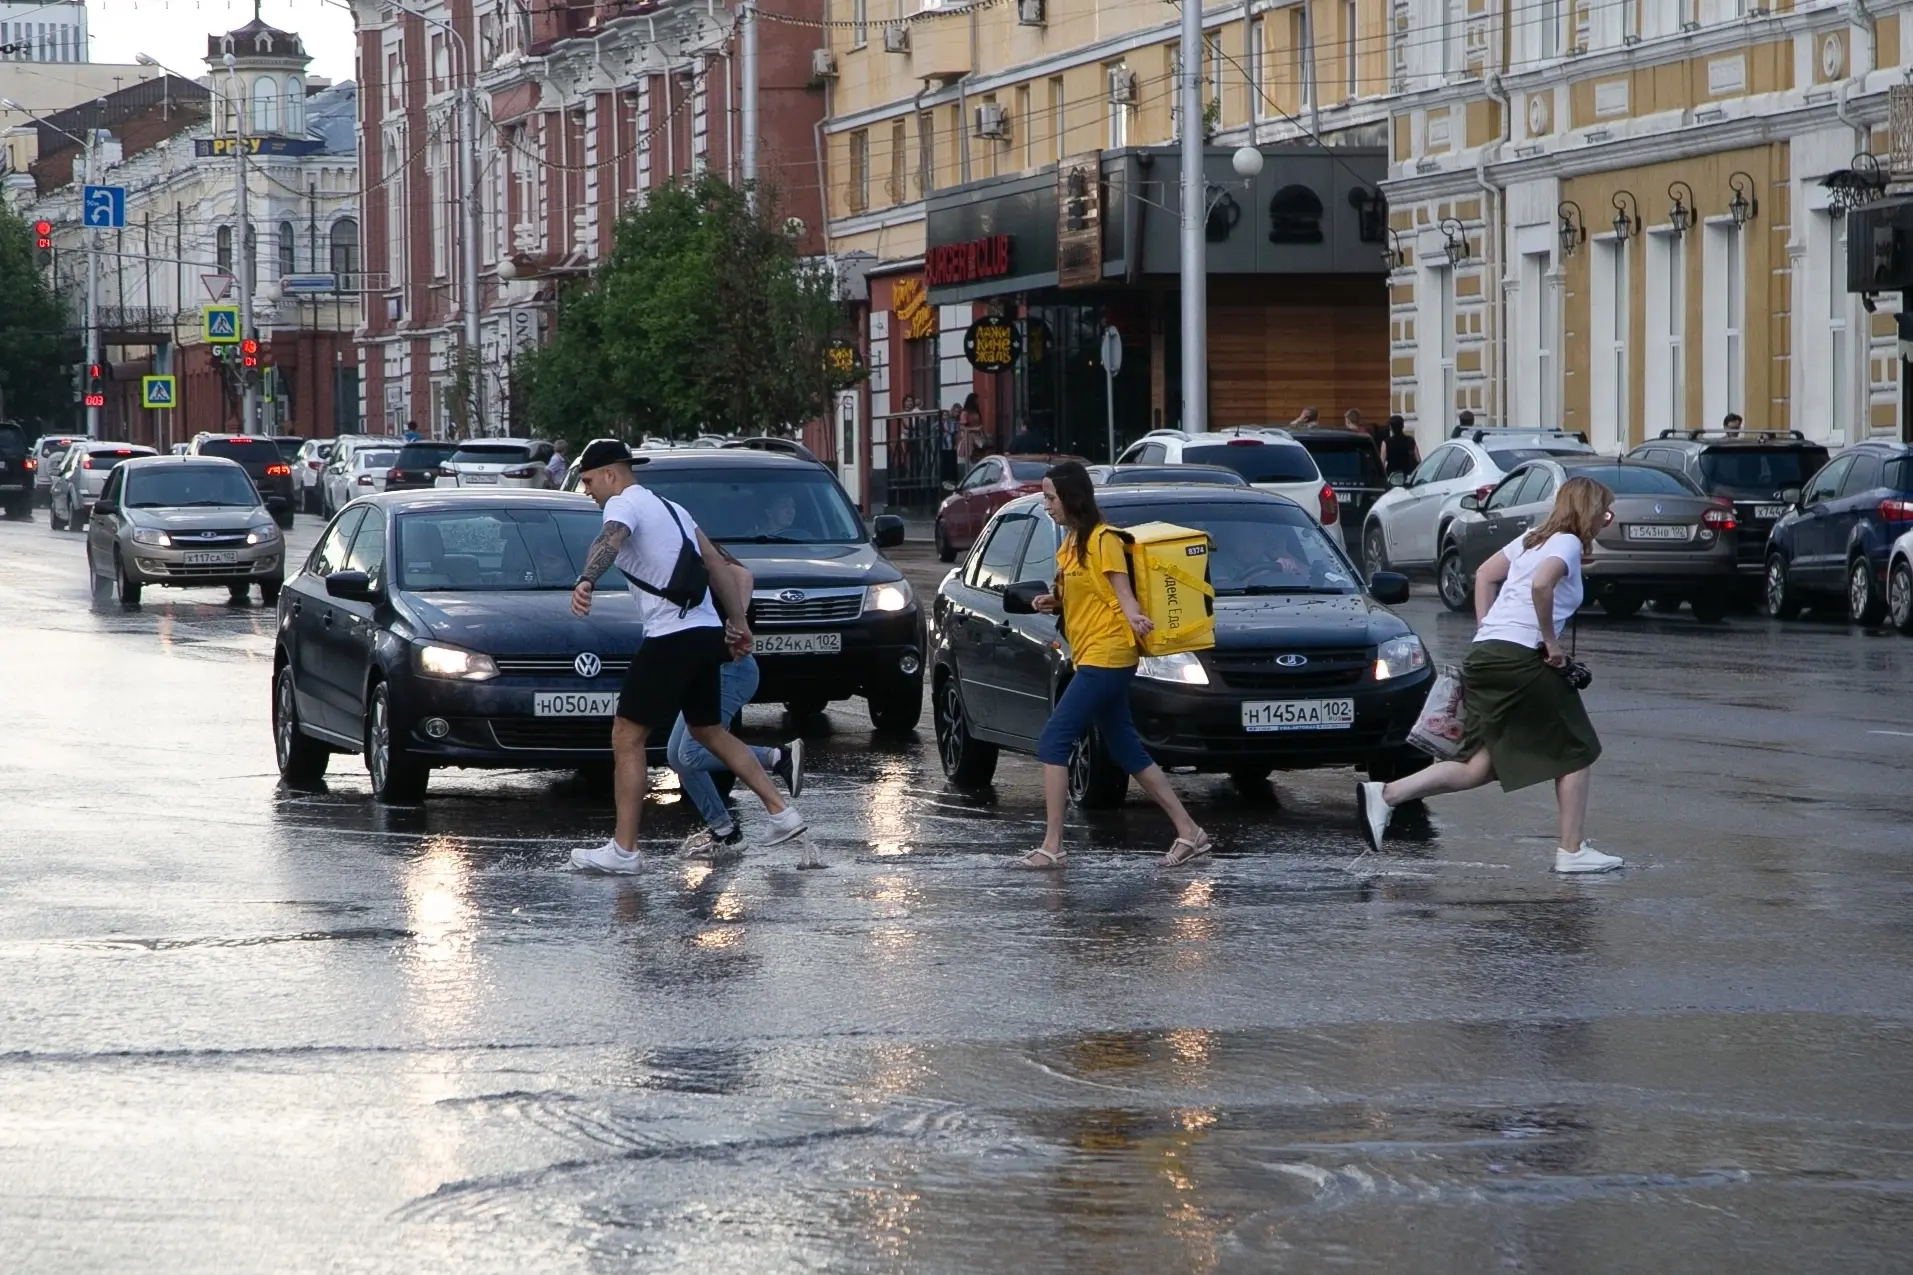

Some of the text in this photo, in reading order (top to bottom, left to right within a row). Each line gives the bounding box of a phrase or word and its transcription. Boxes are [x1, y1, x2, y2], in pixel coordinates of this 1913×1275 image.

[39, 239, 51, 248] 04
[924, 234, 1008, 286] BURGER CLUB
[1187, 547, 1205, 555] 8374
[1168, 608, 1183, 630] Еда
[755, 634, 838, 652] В624КА 102
[541, 695, 611, 714] Н050АУ
[1249, 701, 1349, 723] Н145АА 102
